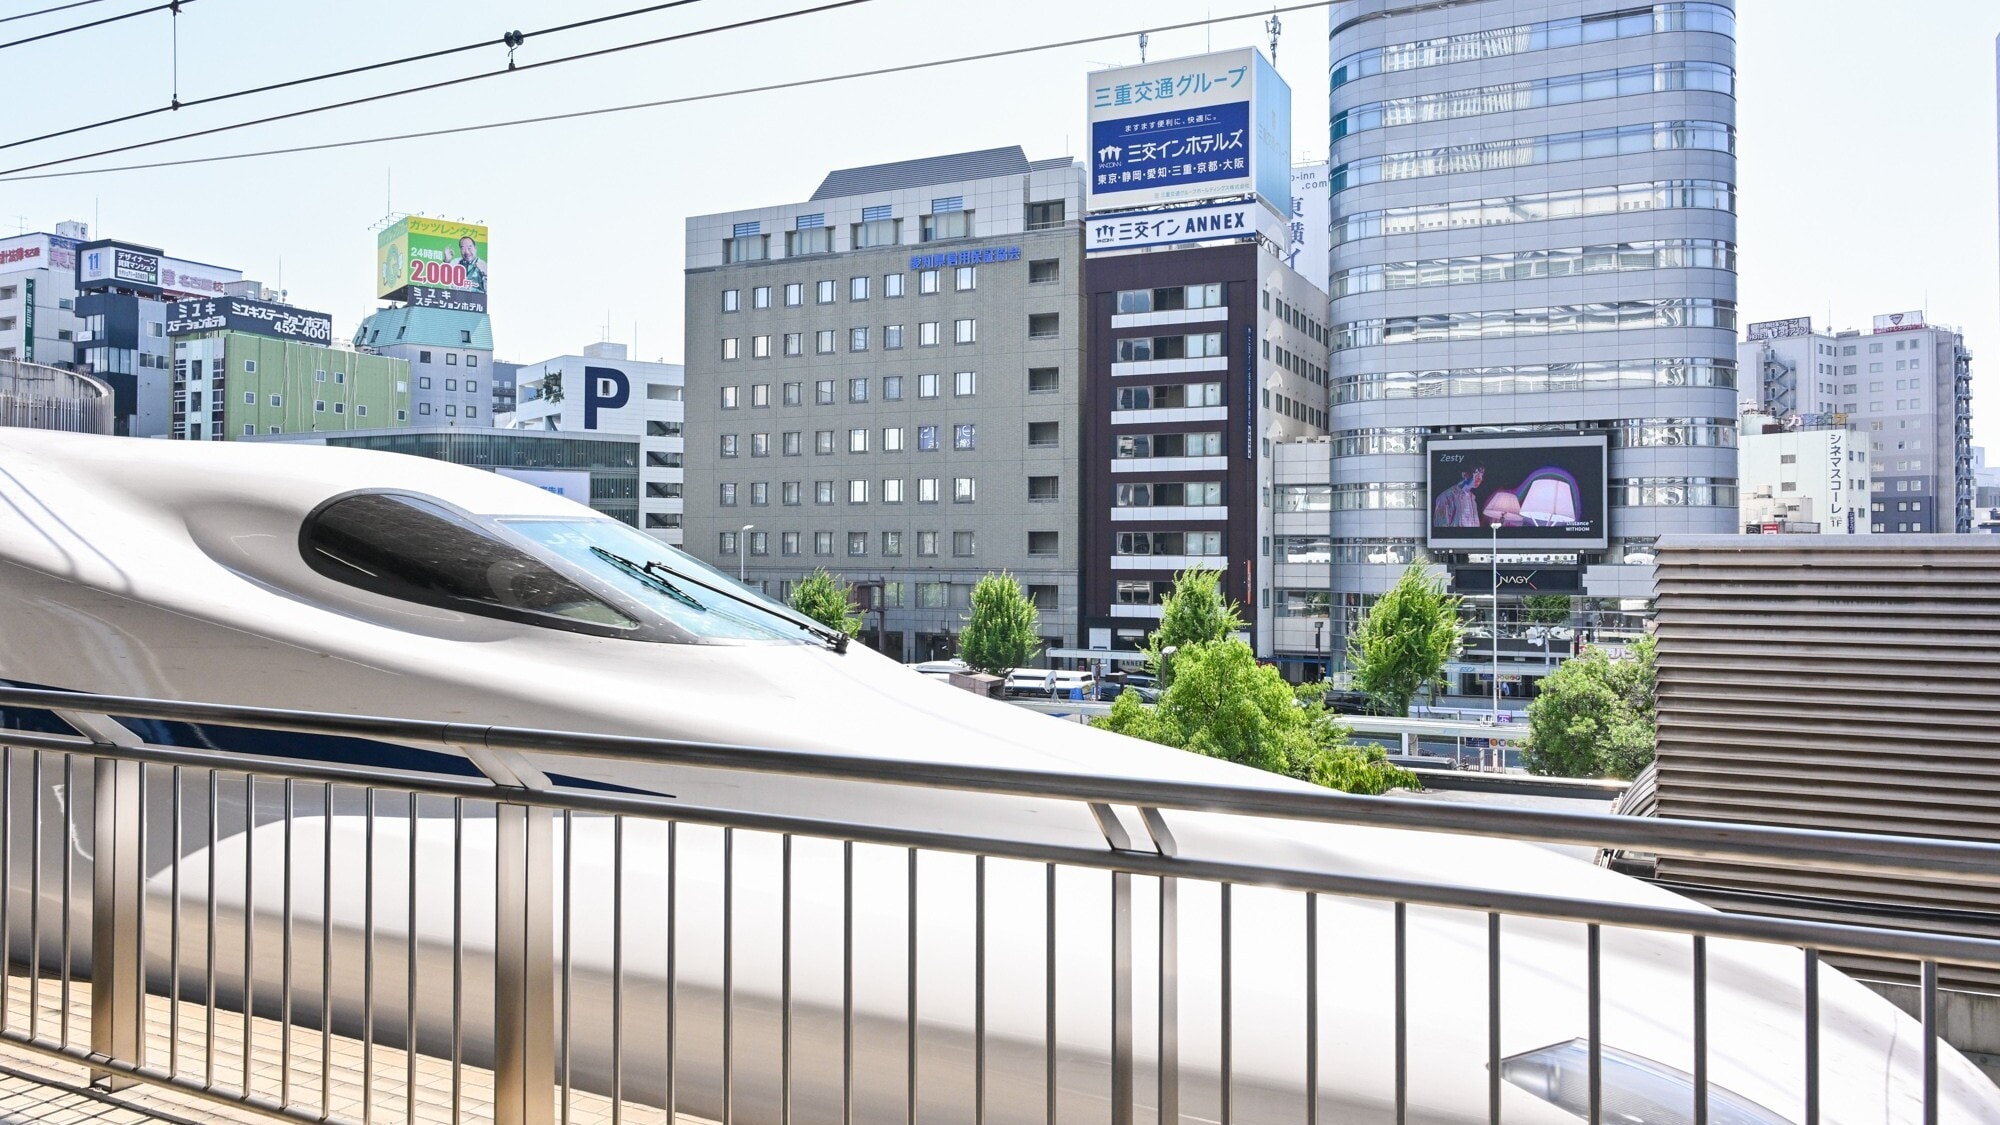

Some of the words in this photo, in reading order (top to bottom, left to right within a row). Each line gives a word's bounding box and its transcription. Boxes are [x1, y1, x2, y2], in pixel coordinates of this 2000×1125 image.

[1094, 65, 1248, 108] 三重交通グループ
[1125, 113, 1217, 133] ますます便利に、快適に。
[1127, 129, 1244, 164] 三交インホテルズ
[1302, 180, 1328, 190] .com
[409, 220, 487, 238] ガッツレンタカー
[1119, 218, 1180, 241] 三交イン
[1185, 212, 1245, 233] ANNEX
[88, 252, 99, 270] 11
[118, 252, 157, 266] デザイナーズ
[410, 247, 443, 260] 24時間
[909, 246, 1020, 270] 愛知県信用保証協会
[413, 287, 451, 299] ミユキ
[179, 302, 215, 318] ミユキ
[415, 297, 484, 312] ステーションホテル
[167, 315, 226, 332] ステーションホテル
[232, 302, 331, 330] ミユキステーションホテル
[274, 321, 331, 340] 452-4001
[584, 366, 630, 430] P
[1440, 453, 1465, 463] Zesty
[1830, 434, 1842, 514] シネマスコーレ
